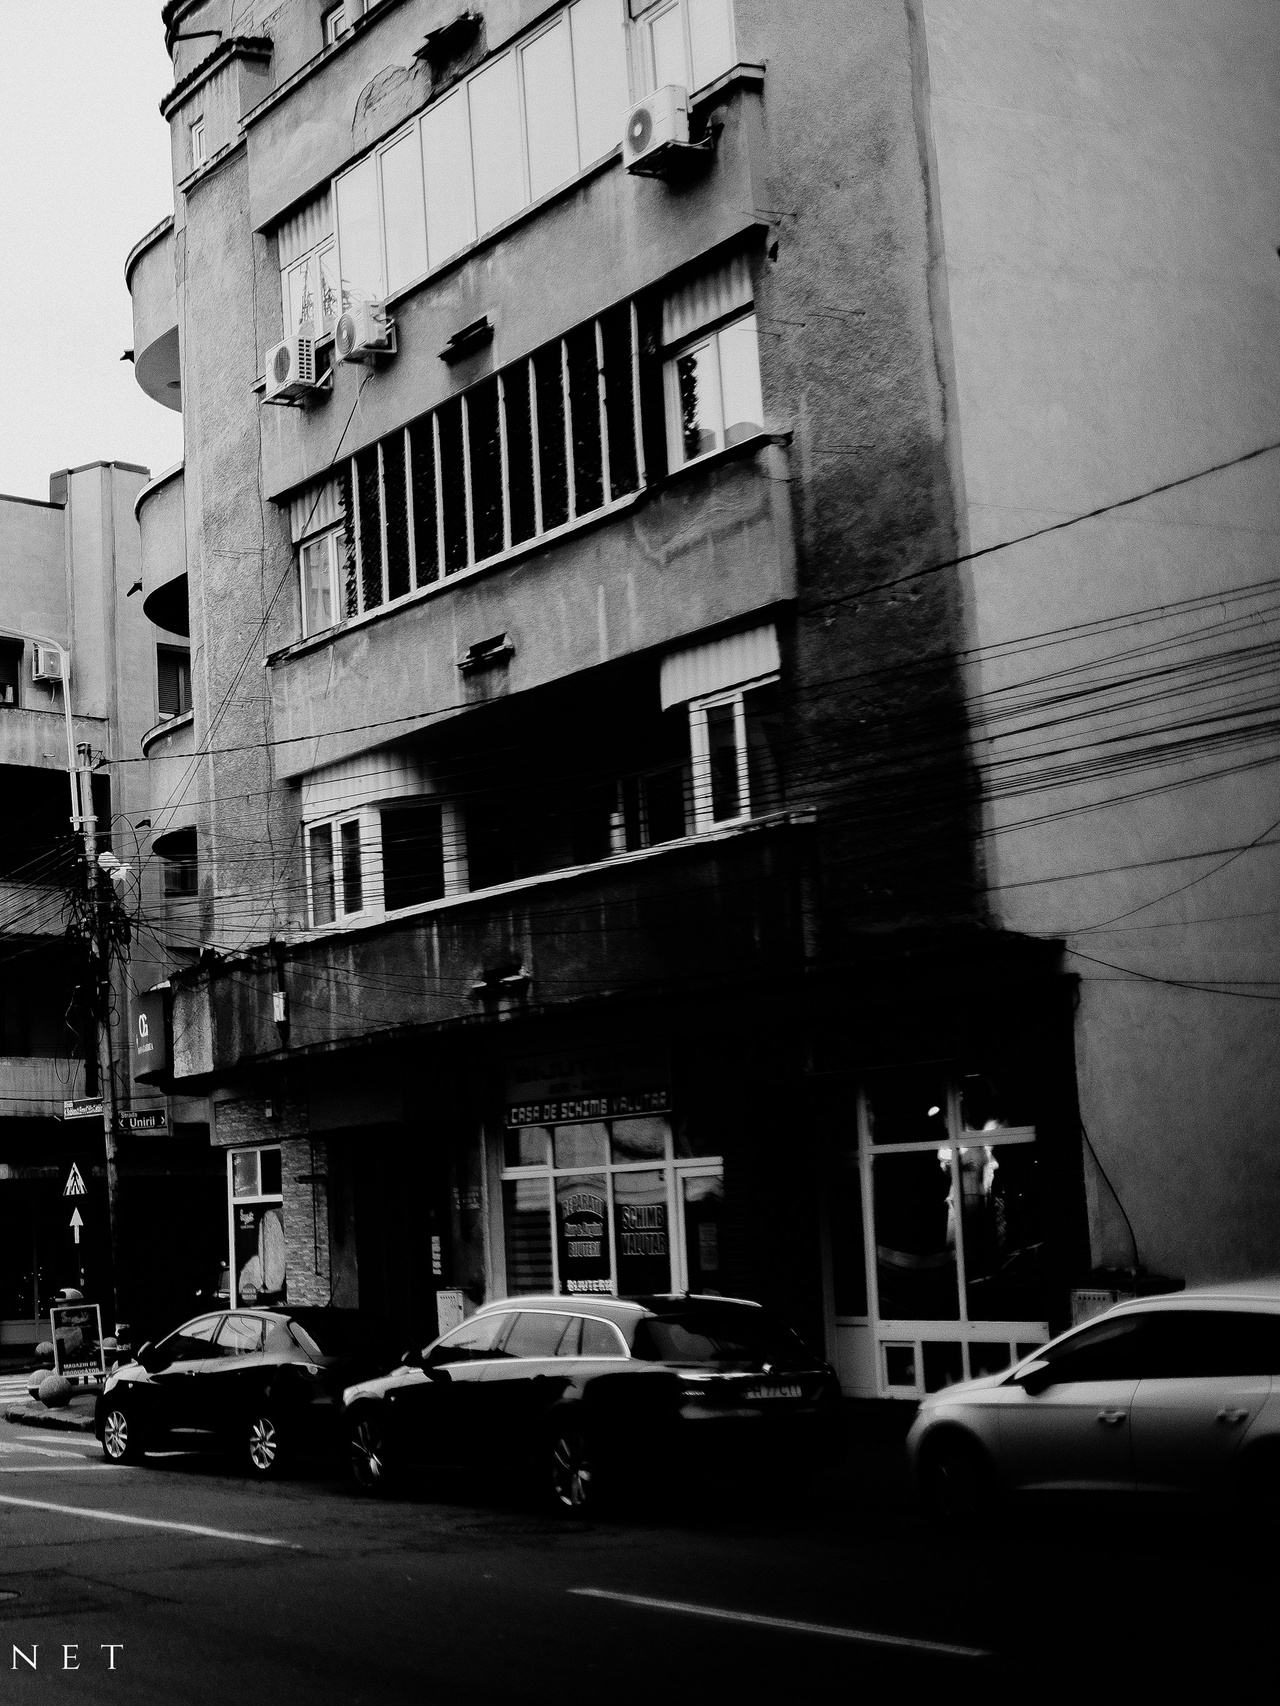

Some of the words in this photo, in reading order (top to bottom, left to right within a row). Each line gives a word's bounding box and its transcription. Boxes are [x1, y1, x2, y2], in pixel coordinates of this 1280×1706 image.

[510, 1105, 540, 1124] CASA
[543, 1103, 558, 1121] DE
[561, 1098, 608, 1119] SCHIMB
[612, 1091, 667, 1113] VALUTAR
[129, 1116, 156, 1128] Unirii
[621, 1205, 664, 1230] SCHIMB
[620, 1231, 667, 1256] VALUTAR
